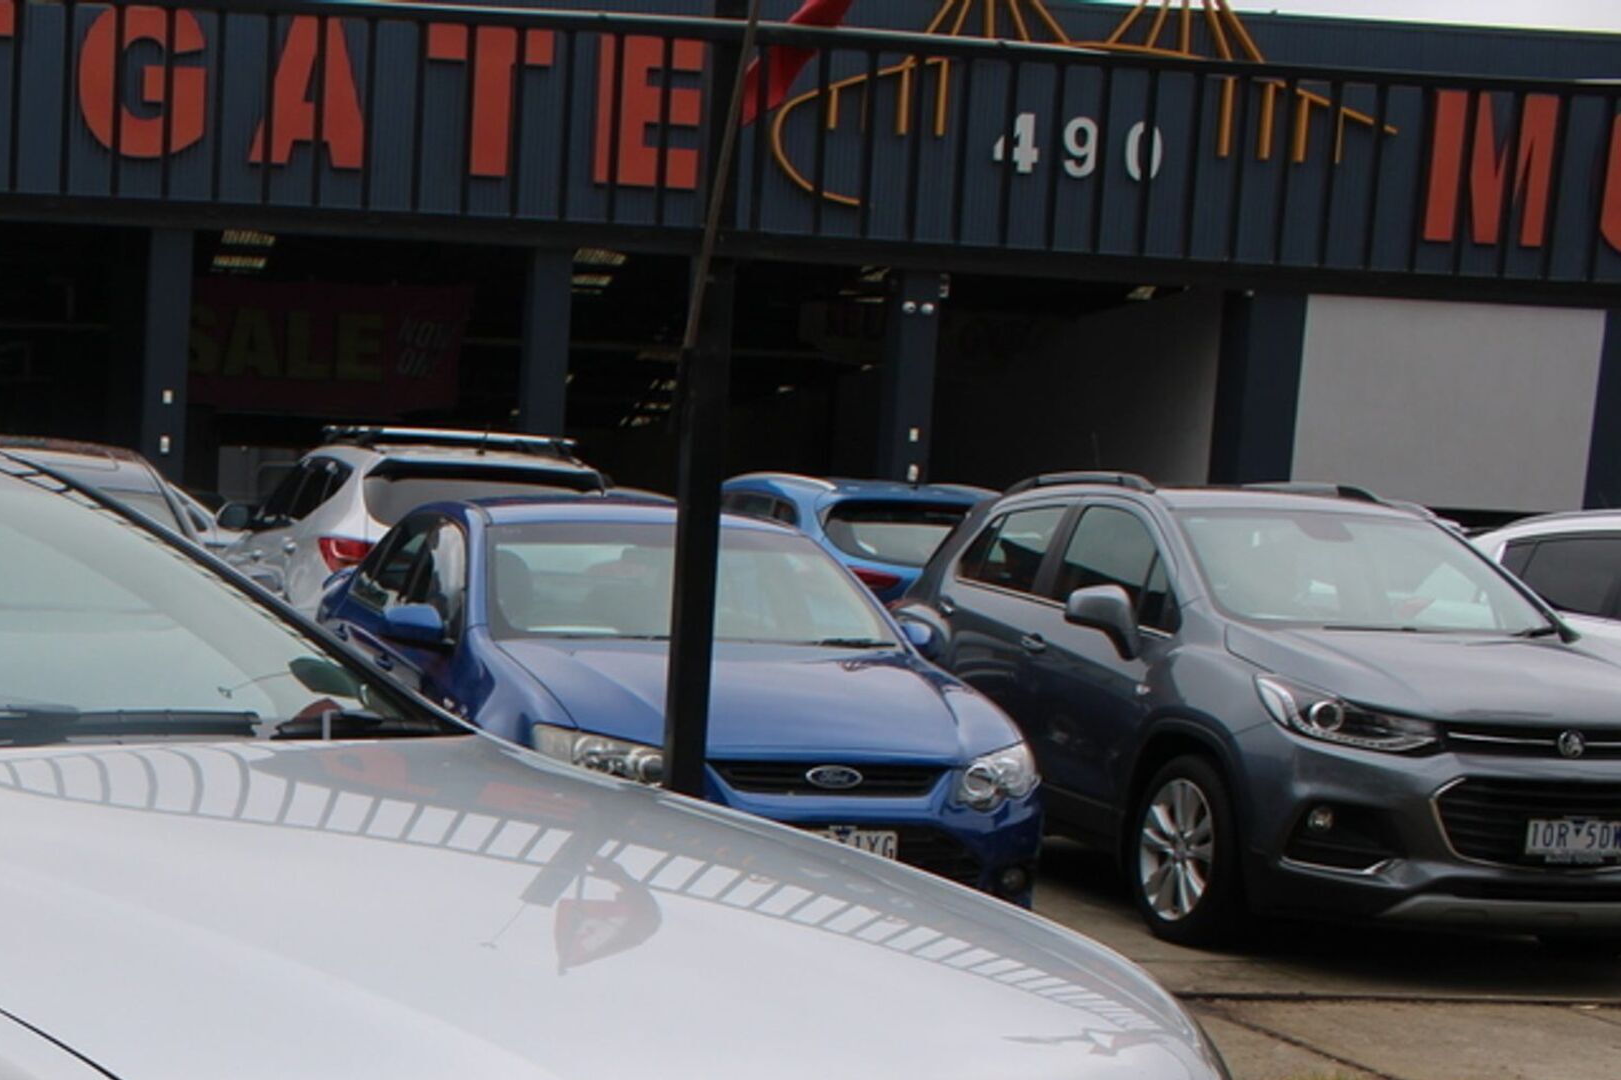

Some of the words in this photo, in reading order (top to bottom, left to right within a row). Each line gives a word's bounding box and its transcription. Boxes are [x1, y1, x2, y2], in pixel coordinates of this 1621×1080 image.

[992, 113, 1163, 181] 490
[1423, 88, 1621, 254] M
[188, 302, 384, 381] SALE
